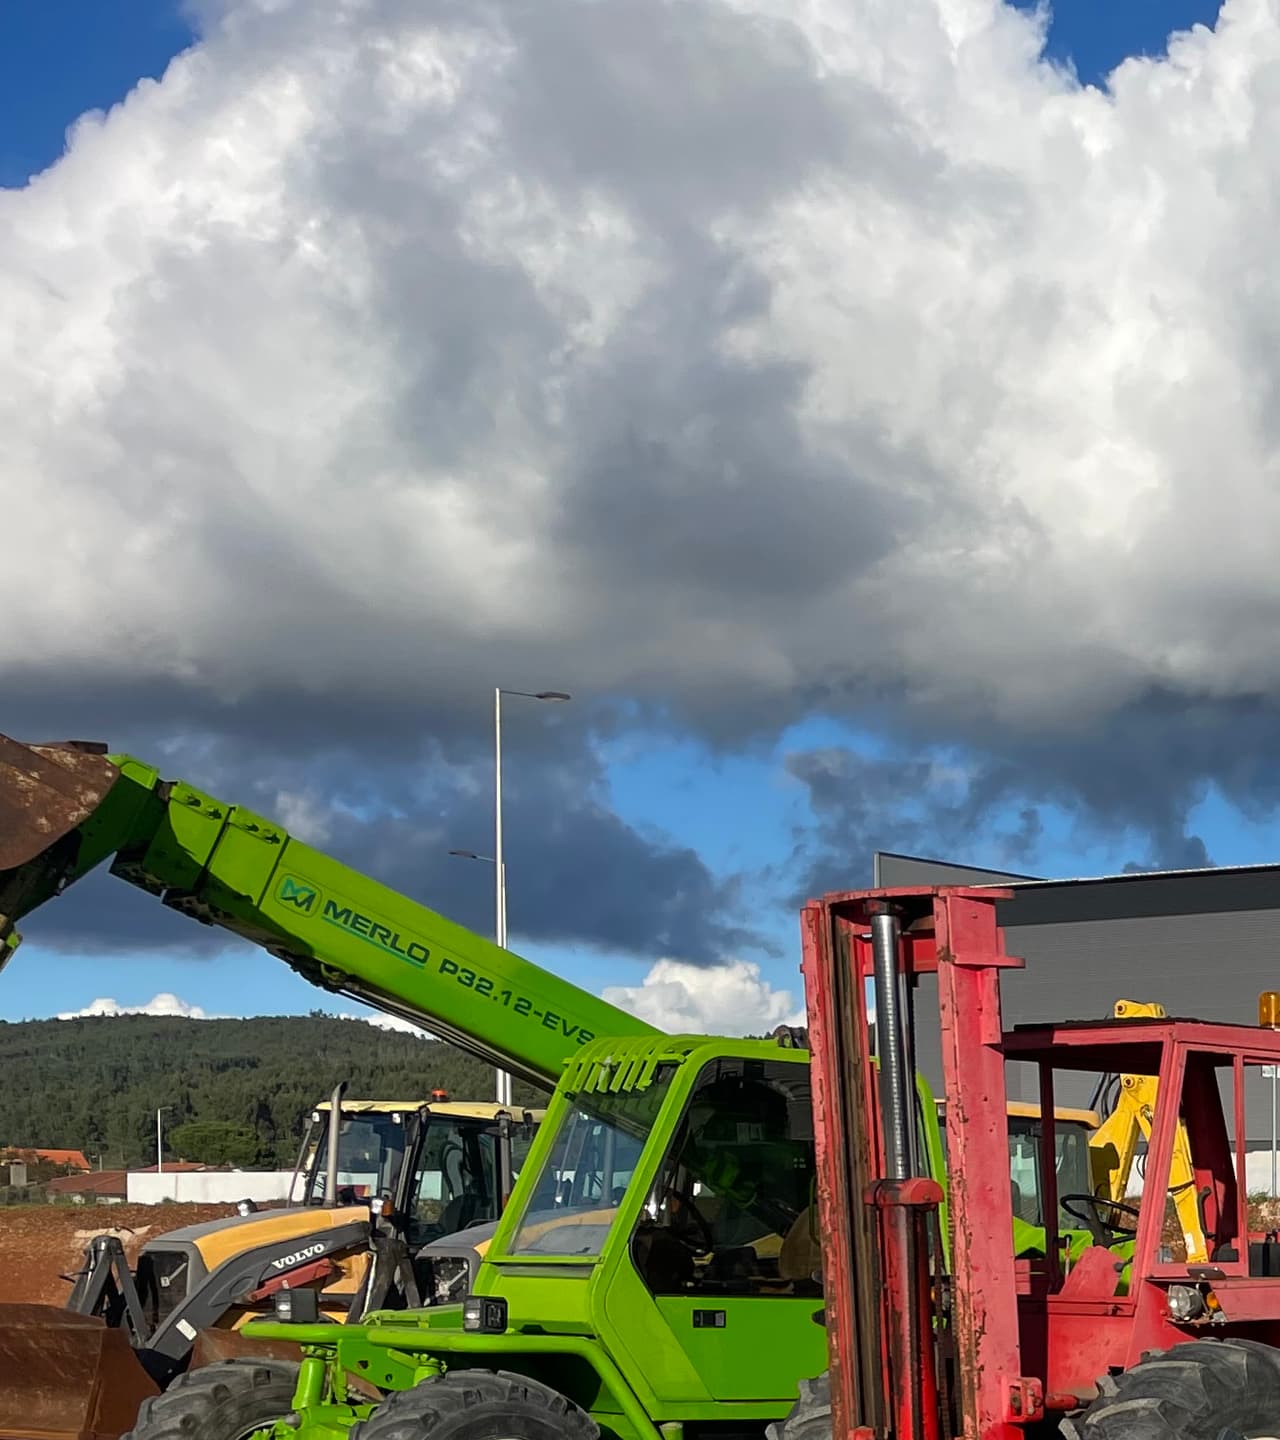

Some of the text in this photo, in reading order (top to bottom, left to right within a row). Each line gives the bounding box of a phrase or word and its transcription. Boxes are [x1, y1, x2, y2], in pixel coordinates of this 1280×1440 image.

[323, 900, 595, 1046] MERLO P32.12-EVS
[272, 1243, 325, 1269] VOLVO
